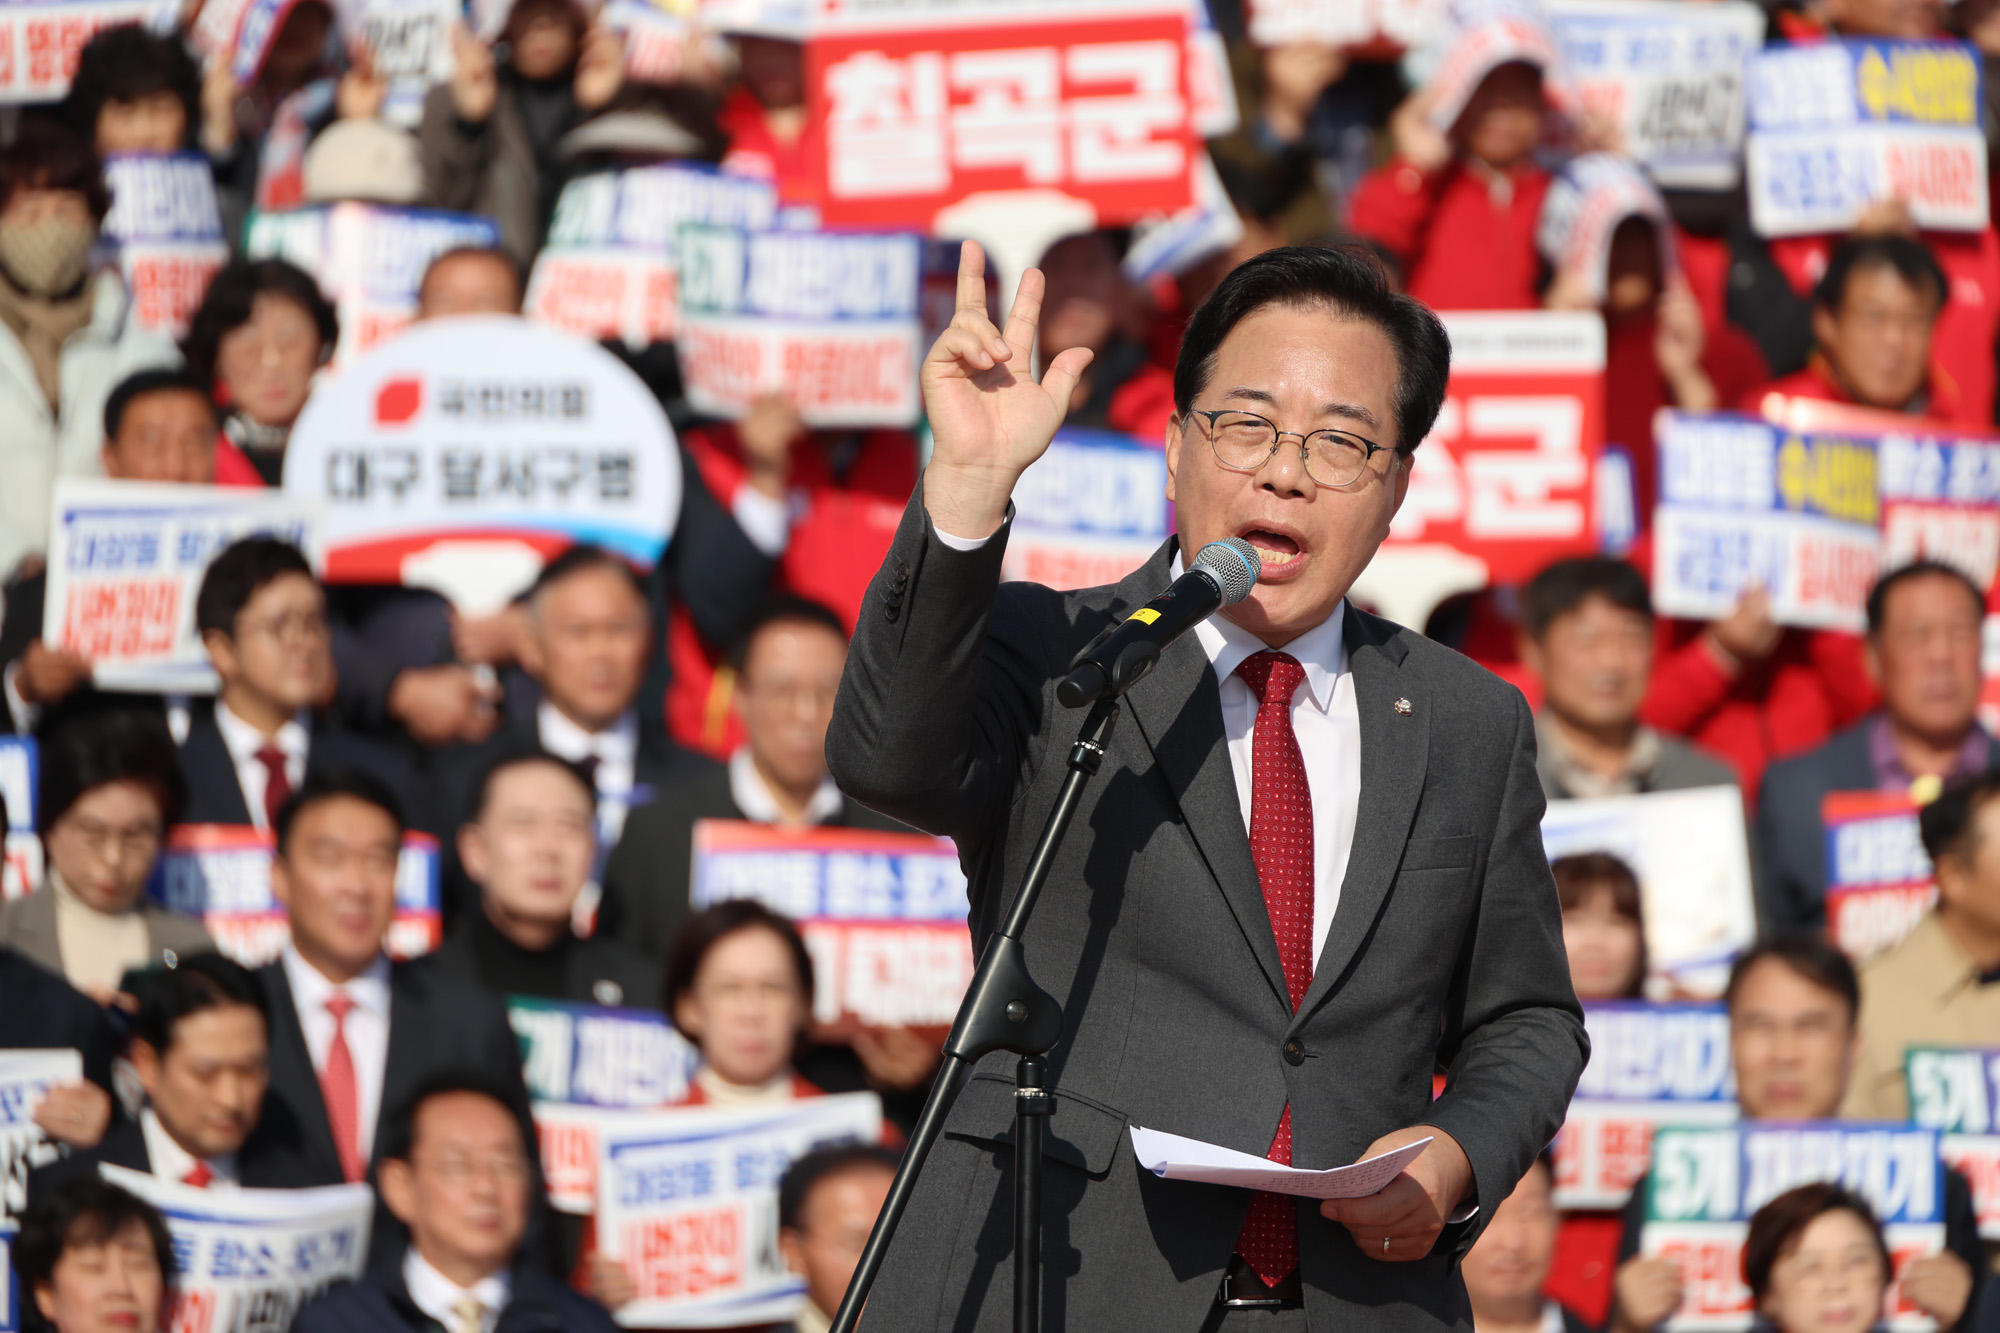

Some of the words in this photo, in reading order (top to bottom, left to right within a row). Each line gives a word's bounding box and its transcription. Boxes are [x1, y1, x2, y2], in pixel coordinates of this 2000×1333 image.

[826, 38, 1187, 202] 칠곡군
[438, 376, 588, 420] 국민의힘
[325, 442, 421, 502] 대구
[437, 442, 637, 502] 달서구병
[1655, 1131, 1741, 1220] 5개
